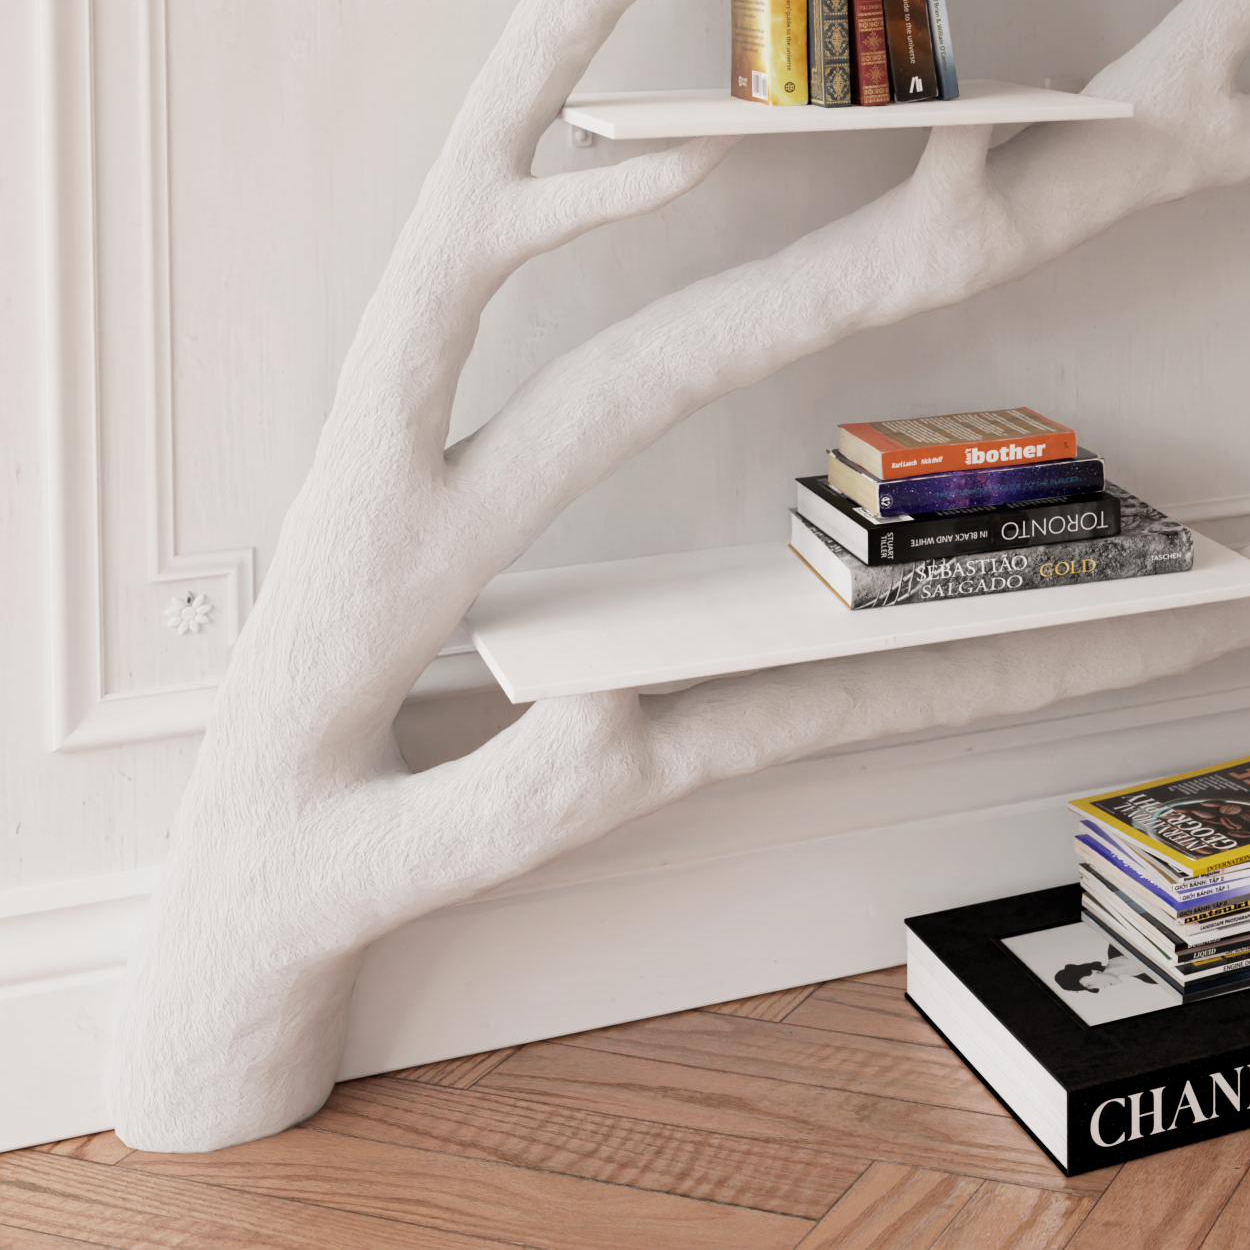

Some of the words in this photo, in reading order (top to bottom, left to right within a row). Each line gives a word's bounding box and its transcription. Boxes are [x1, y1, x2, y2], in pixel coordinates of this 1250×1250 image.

[905, 13, 910, 21] to
[907, 36, 915, 64] universe
[972, 444, 1046, 464] bother
[1001, 510, 1108, 540] TORONTO
[936, 536, 953, 544] AND
[954, 533, 978, 541] BLACK
[979, 530, 988, 538] IN
[911, 538, 934, 547] WHITE
[1150, 552, 1182, 562] TASCHEN
[916, 554, 1028, 581] SEBASTIÃO
[1040, 559, 1096, 577] GOLD
[921, 575, 1023, 599] SALGADO
[1114, 803, 1207, 851] INTERNATIONAL
[1122, 793, 1237, 849] GEOGRAPHY
[1184, 900, 1249, 924] matsuki
[1200, 920, 1224, 930] LANDSCAPE
[1193, 948, 1216, 958] LIQUID
[1223, 962, 1244, 972] ENGINE
